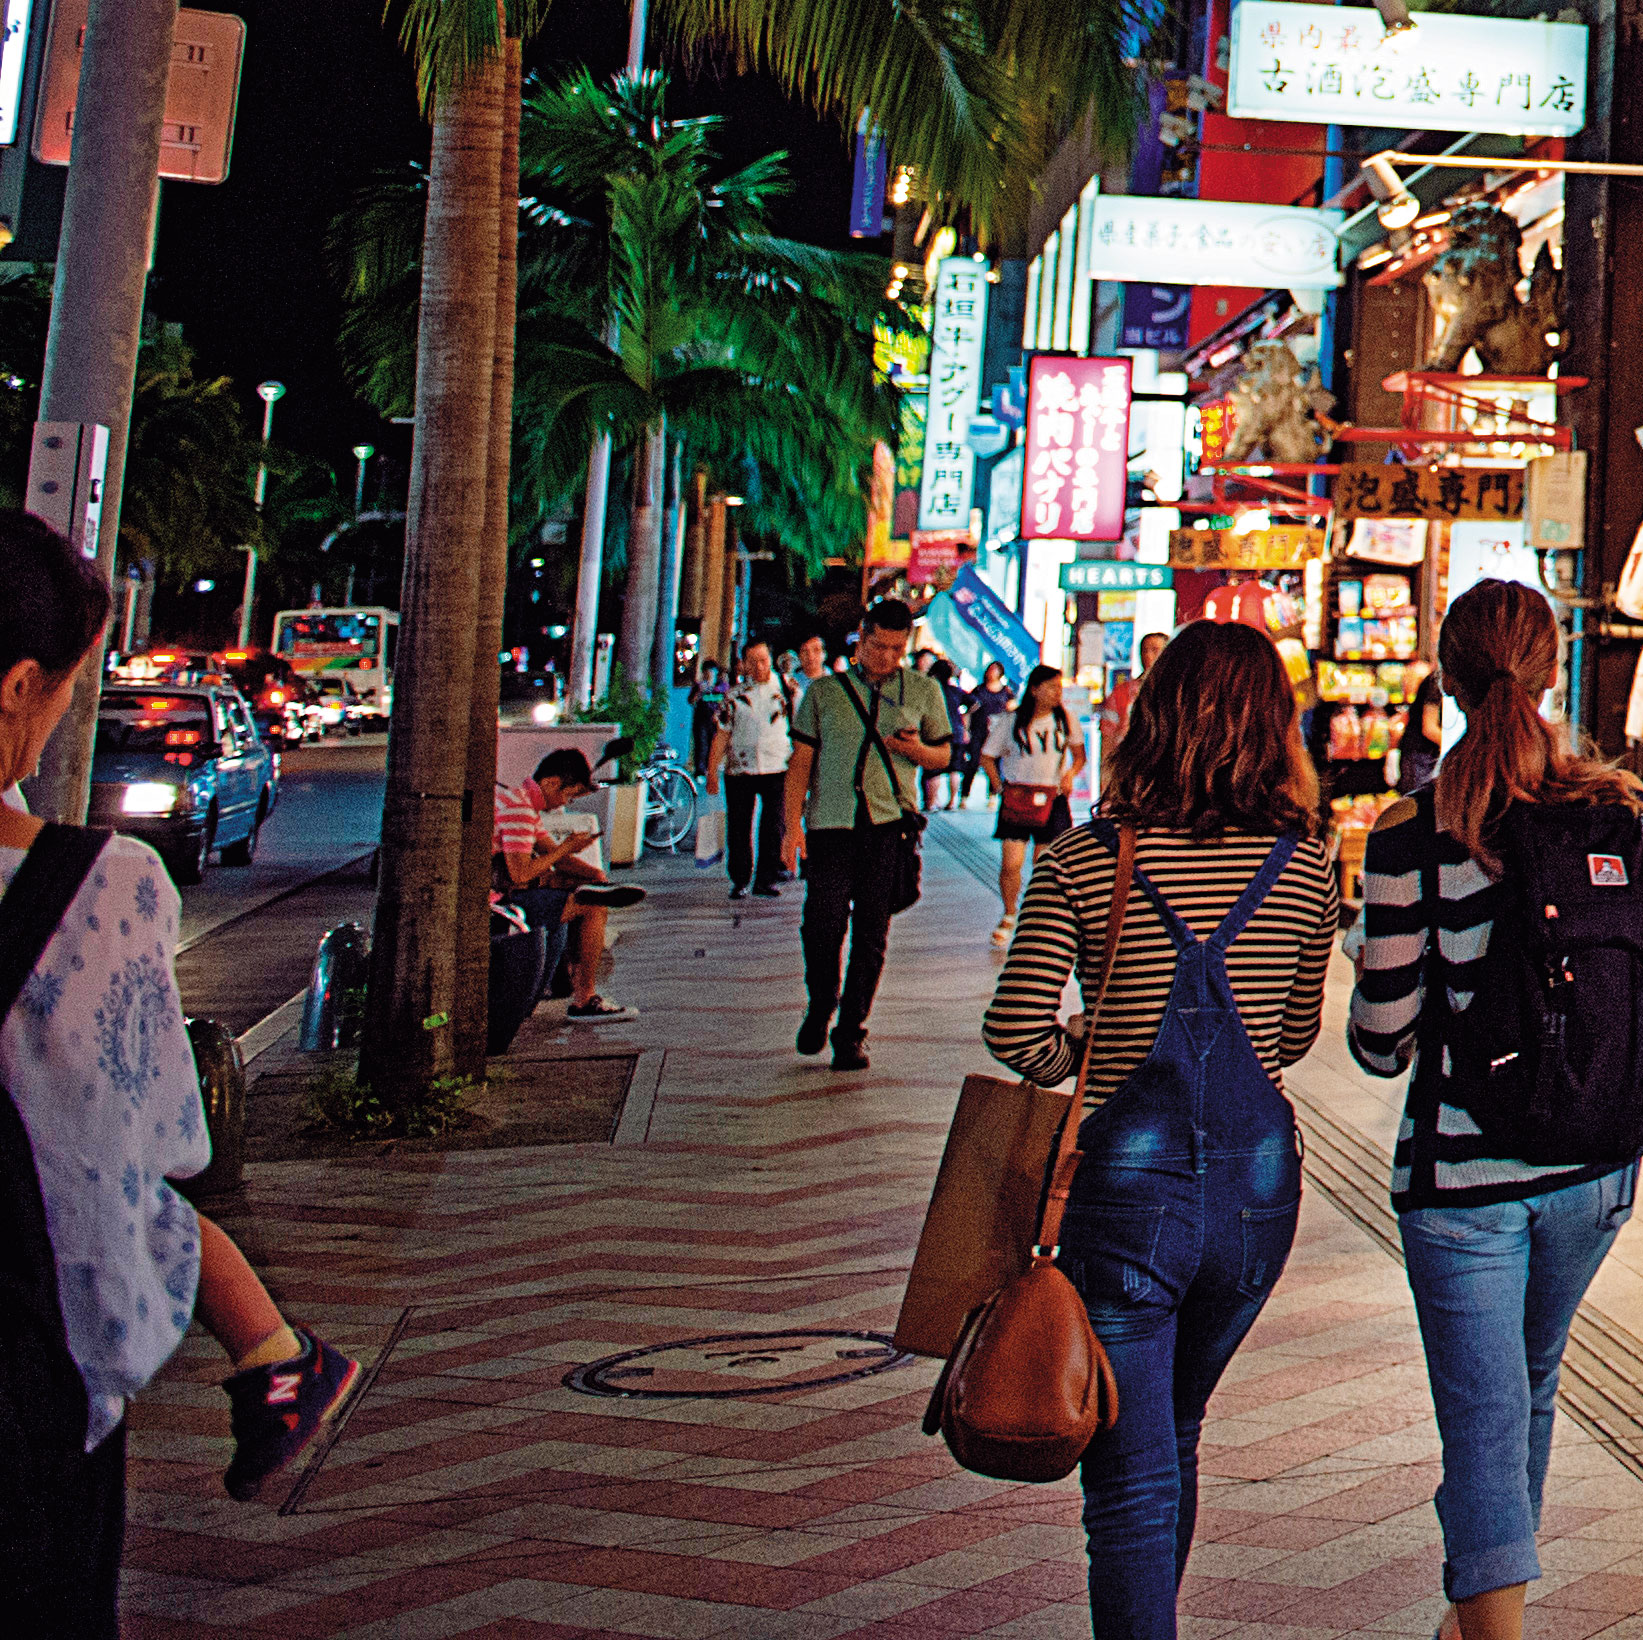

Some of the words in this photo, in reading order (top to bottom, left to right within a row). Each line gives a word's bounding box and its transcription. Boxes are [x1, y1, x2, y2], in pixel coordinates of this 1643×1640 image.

[1260, 58, 1575, 112] 古酒泡盛専門店
[1344, 467, 1524, 517] 泡盛専門
[1068, 565, 1165, 587] HEARTS
